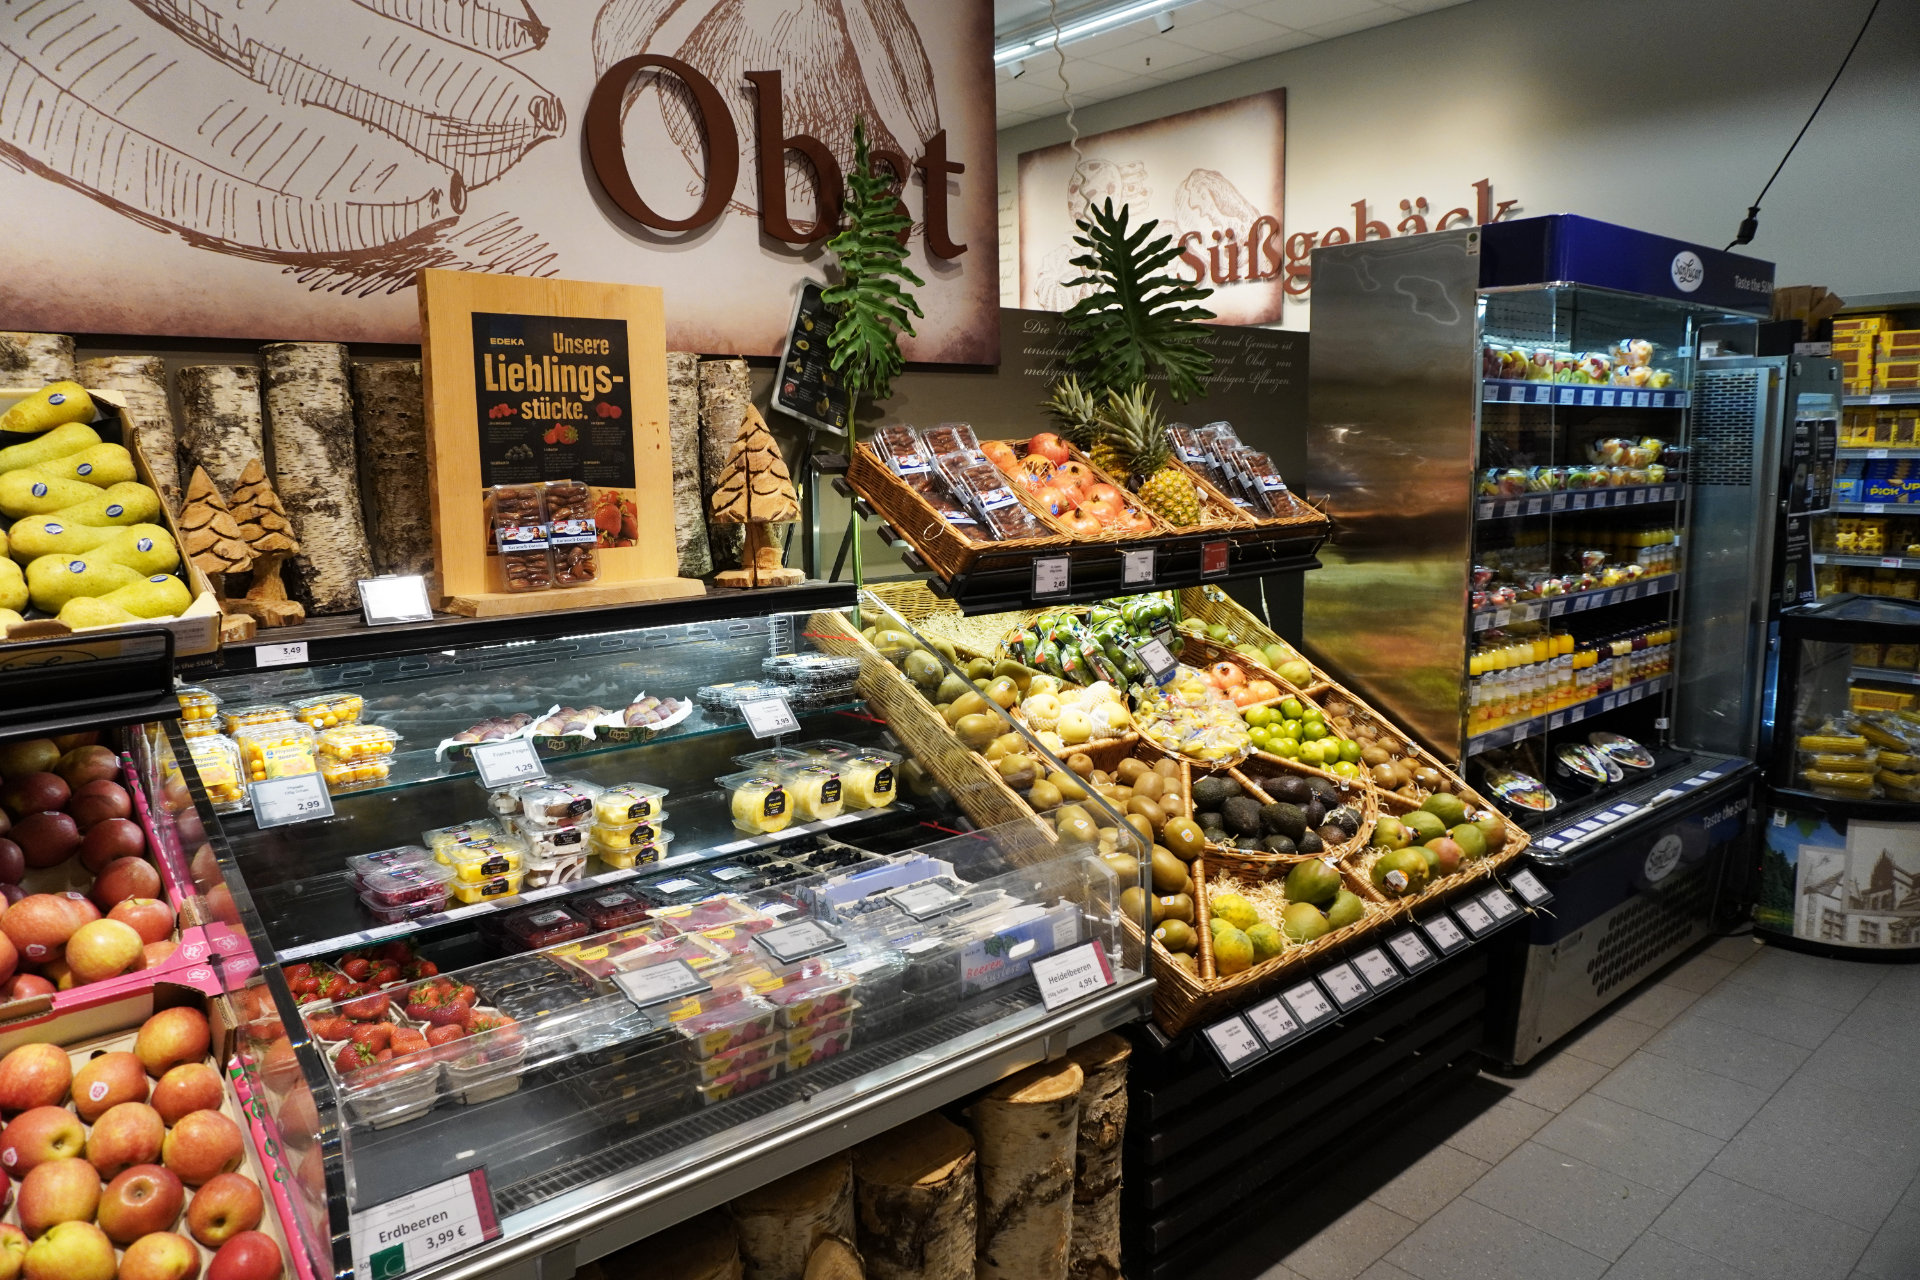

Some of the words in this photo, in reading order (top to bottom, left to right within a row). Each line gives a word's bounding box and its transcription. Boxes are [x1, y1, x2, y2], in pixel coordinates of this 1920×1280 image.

[1734, 275, 1750, 290] Taste
[1751, 277, 1760, 291] the
[490, 337, 525, 346] EDEKA
[553, 332, 610, 355] Unsere
[483, 353, 624, 402] Lieblings-
[521, 396, 589, 420] stücke.
[283, 646, 301, 656] 3,49
[514, 763, 534, 772] 1,29
[297, 800, 320, 811] 2,99
[1048, 963, 1092, 985] Heidelbeeren
[1078, 977, 1093, 989] 4,99
[1093, 975, 1099, 983] €
[1279, 1020, 1293, 1031] 2,99
[1241, 1039, 1255, 1050] 1,99
[379, 1209, 449, 1243] Erdbeeren
[426, 1230, 455, 1250] 3,99
[457, 1224, 467, 1237] €
